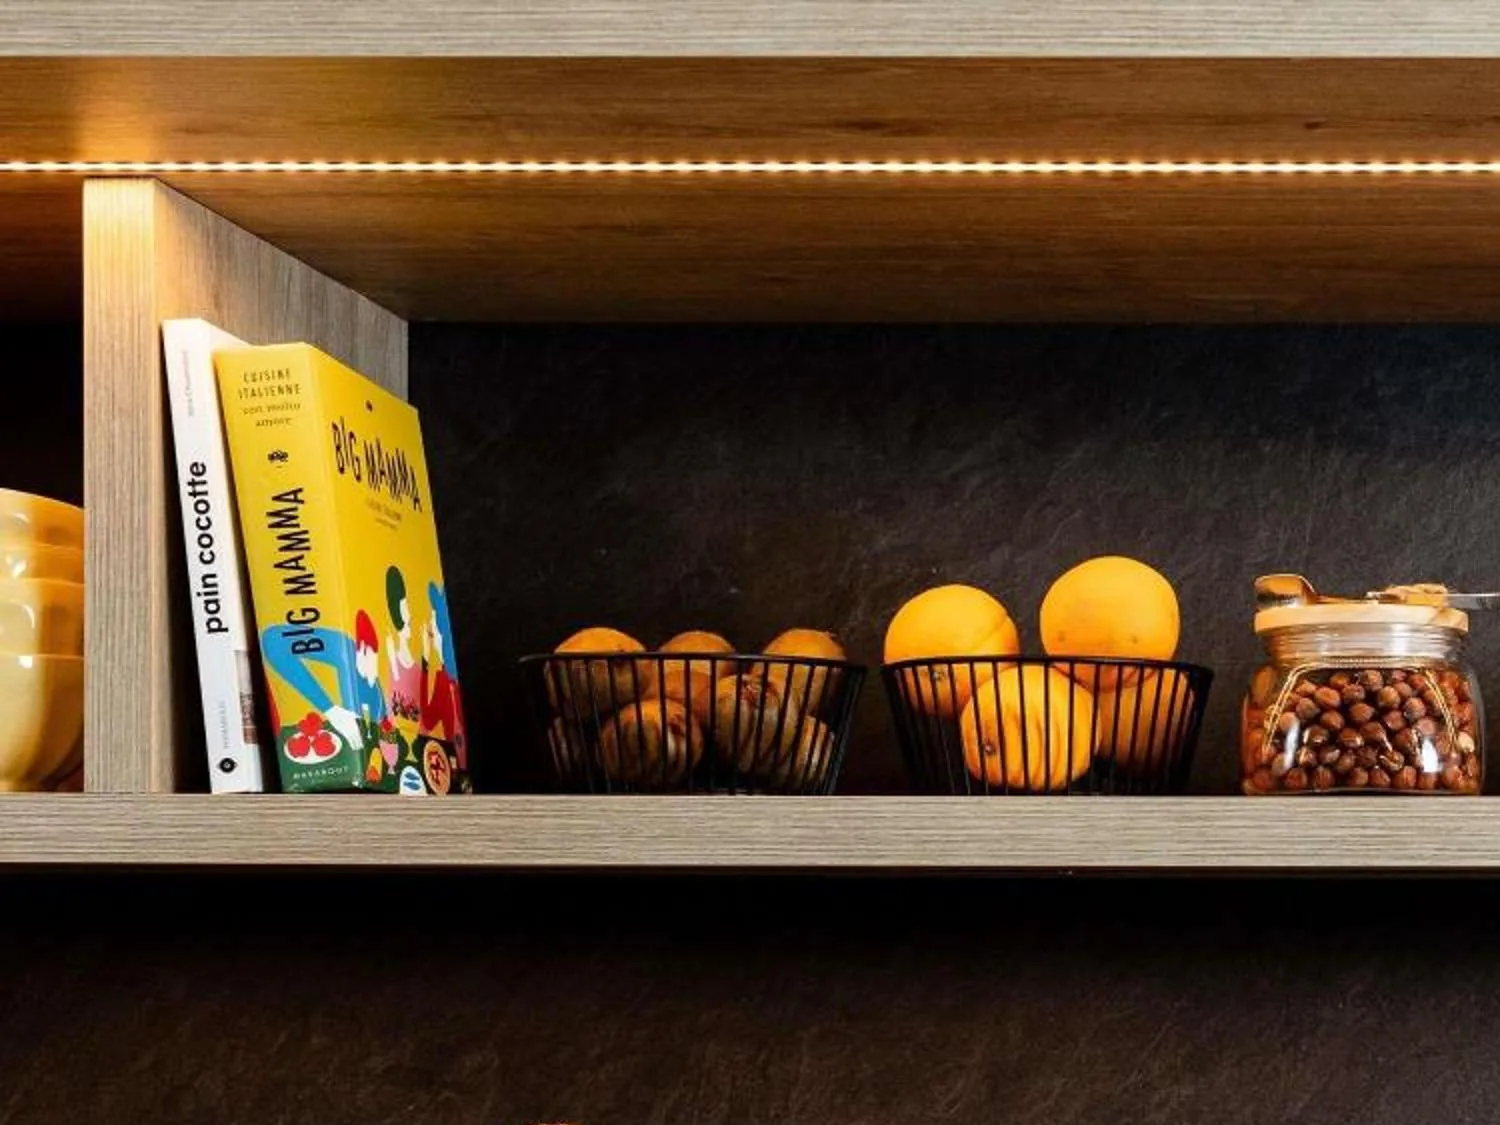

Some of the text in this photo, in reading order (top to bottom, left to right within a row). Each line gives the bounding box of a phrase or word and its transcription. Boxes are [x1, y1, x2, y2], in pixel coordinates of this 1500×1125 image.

[238, 384, 302, 399] ITALIENNE
[331, 415, 423, 513] BIG MAMMA
[187, 461, 229, 634] pain cocotte
[265, 487, 325, 655] BIG MAMMA
